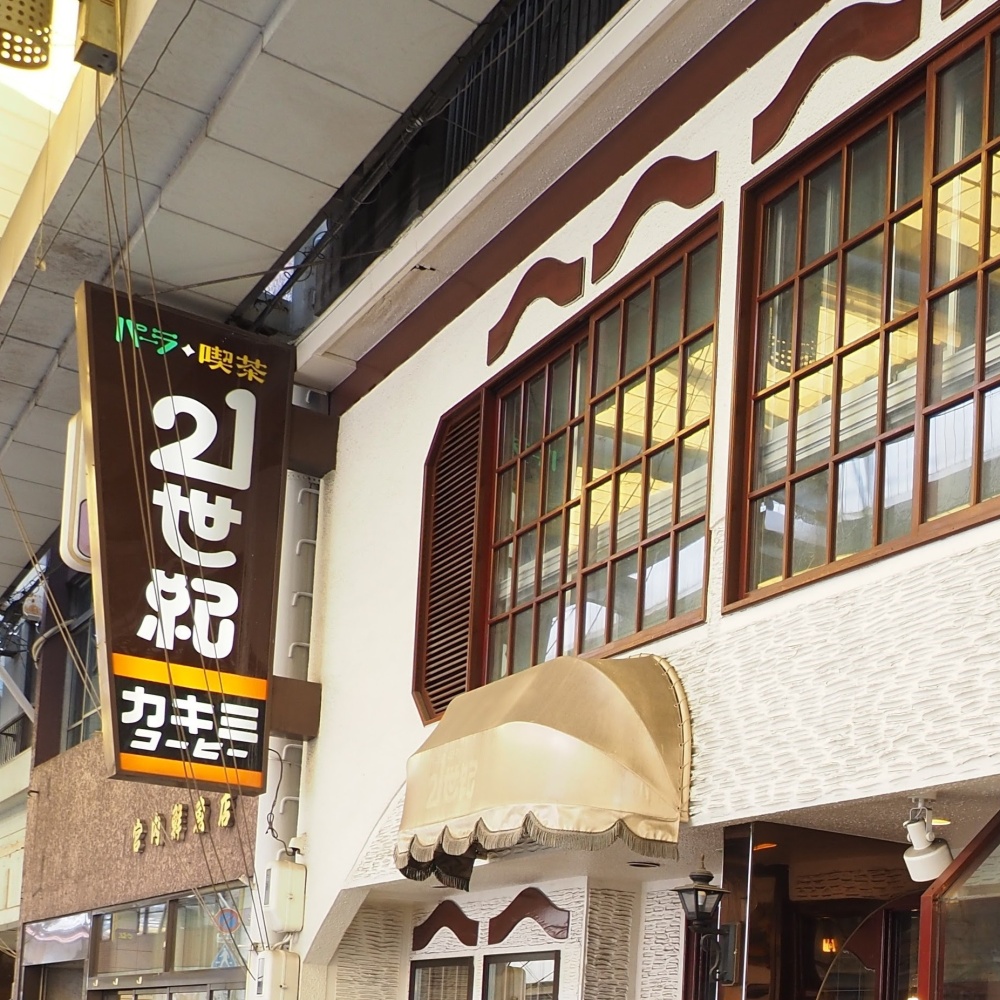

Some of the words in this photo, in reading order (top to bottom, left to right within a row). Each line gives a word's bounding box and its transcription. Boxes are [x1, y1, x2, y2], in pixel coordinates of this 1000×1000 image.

[198, 343, 268, 384] 喫茶
[136, 388, 257, 660] 21世紀
[119, 685, 260, 746] カキミ
[130, 728, 249, 760] コーヒー
